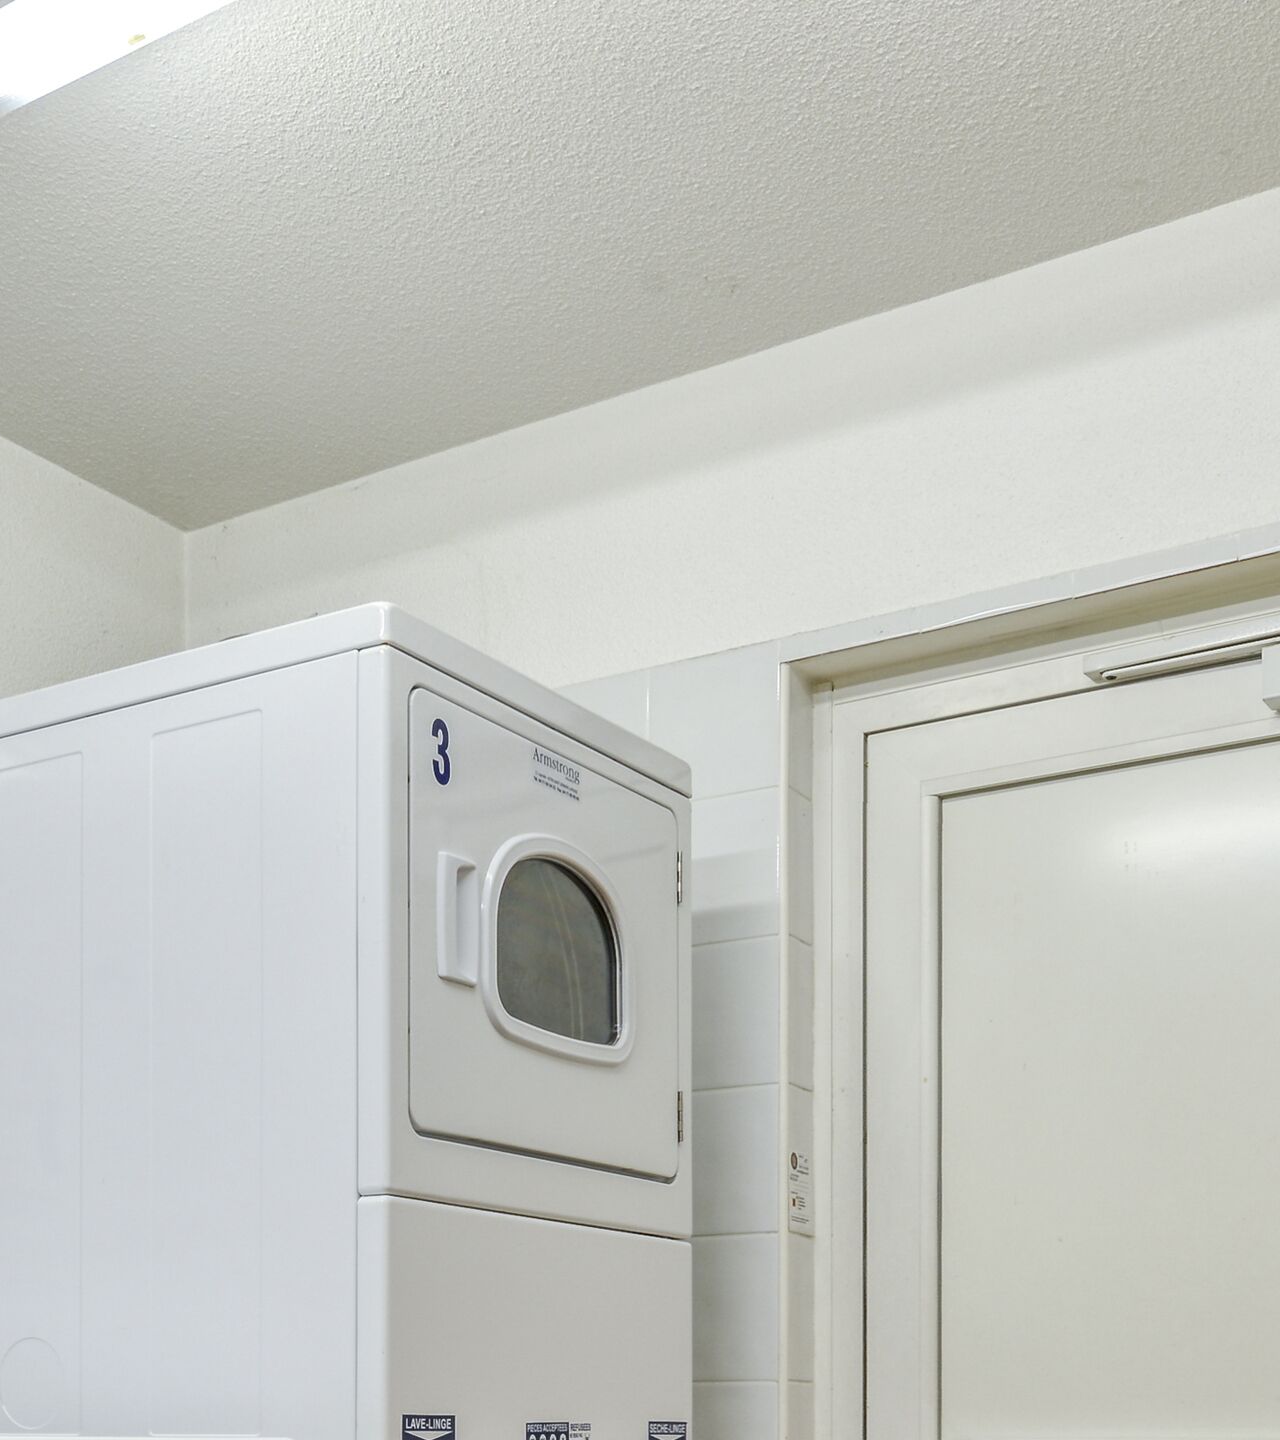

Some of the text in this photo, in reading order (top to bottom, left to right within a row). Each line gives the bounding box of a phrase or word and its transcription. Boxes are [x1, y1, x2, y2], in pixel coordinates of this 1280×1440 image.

[432, 719, 451, 785] 3
[533, 748, 580, 783] Armstrong
[405, 1418, 453, 1431] LAVE-LINGE
[649, 1423, 686, 1434] SECHE-LINGE
